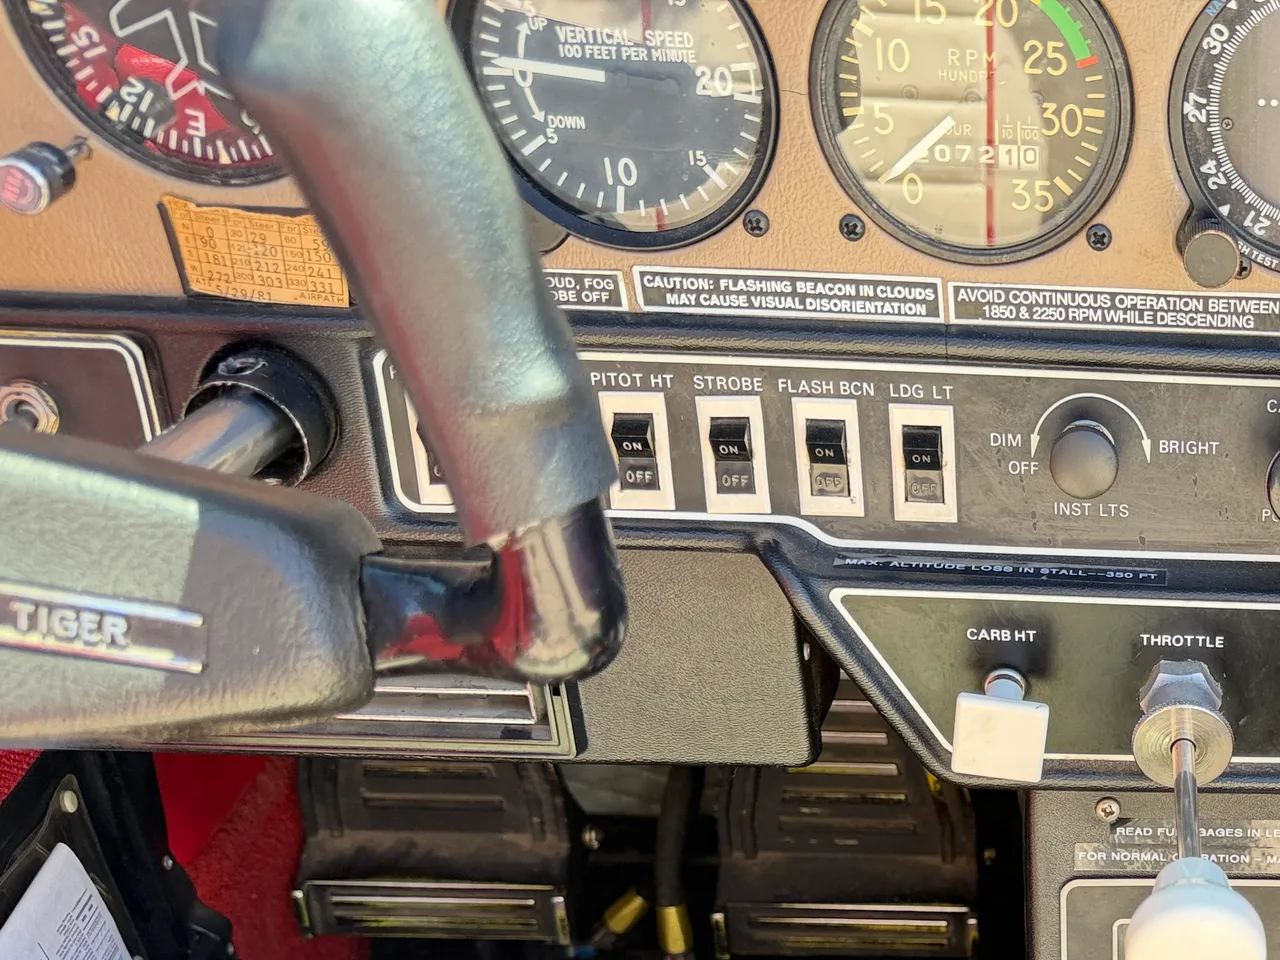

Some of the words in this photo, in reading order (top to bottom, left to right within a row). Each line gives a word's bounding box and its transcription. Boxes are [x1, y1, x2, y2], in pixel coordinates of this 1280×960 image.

[529, 16, 547, 31] UP
[555, 26, 635, 46] VERTICAL
[644, 29, 694, 48] SPEED
[1202, 23, 1229, 55] 30
[557, 45, 581, 59] 100
[586, 46, 619, 60] FEET
[620, 48, 648, 62] PER
[651, 49, 696, 63] MINUTE
[876, 37, 910, 73] 10
[1023, 39, 1067, 75] 25
[694, 65, 733, 97] 20
[547, 115, 586, 130] DOWN
[873, 102, 894, 135] 5
[1041, 102, 1082, 137] 30
[546, 128, 558, 145] 5
[689, 150, 707, 167] 15
[603, 157, 638, 187] 10
[1200, 159, 1227, 190] 24
[902, 173, 923, 205] 0
[1011, 178, 1054, 212] 35
[1243, 210, 1272, 236] 21
[1251, 250, 1279, 269] TEST
[584, 278, 615, 290] FOG
[643, 275, 714, 291] CAUTION:
[719, 278, 792, 295] FLASHING
[795, 281, 856, 297] BEACON
[858, 284, 875, 298] IN
[876, 285, 935, 301] CLOUDS
[300, 292, 345, 304] AIRPATH
[581, 291, 610, 303] OFF
[666, 292, 697, 306] MAY
[698, 293, 750, 309] CAUSE
[750, 294, 805, 310] VISUAL
[805, 298, 927, 317] DISORIENTATION
[957, 288, 1006, 305] AVOID
[1008, 290, 1111, 309] CONTINUOUS
[1114, 294, 1204, 313] OPERATION
[1207, 298, 1280, 315] BETWEEN
[982, 304, 1017, 320] 1850
[1018, 306, 1031, 320] &
[1031, 306, 1067, 322] 2250
[1068, 309, 1103, 323] RPM
[1103, 309, 1154, 326] WHILE
[1156, 312, 1255, 329] DESCENDING
[590, 372, 643, 388] PITOT
[650, 374, 674, 389] HT
[693, 375, 763, 392] STROBE
[777, 378, 834, 394] FLASH
[839, 381, 875, 397] BCN
[889, 383, 925, 399] LDG
[932, 385, 954, 400] LT
[622, 441, 643, 451] ON
[989, 433, 1022, 448] DIM
[1158, 439, 1220, 456] BRIGHT
[719, 444, 739, 455] ON
[814, 448, 834, 457] ON
[912, 454, 931, 463] ON
[1008, 460, 1039, 475] OFF
[625, 470, 653, 484] OFF
[721, 474, 749, 487] OFF
[1053, 502, 1091, 516] INST
[1099, 503, 1130, 518] LTS
[845, 557, 883, 567] MAX.
[889, 560, 966, 571] ALTITUDE
[972, 564, 1013, 574] LOSS
[9, 600, 129, 646] TIGER
[966, 627, 1012, 643] CARB
[1014, 630, 1037, 644] HT
[1139, 633, 1225, 649] THROTTLE
[1116, 827, 1152, 837] READ
[1247, 828, 1261, 838] IN
[1078, 851, 1107, 862] FOR
[1111, 851, 1167, 862] NORMAL
